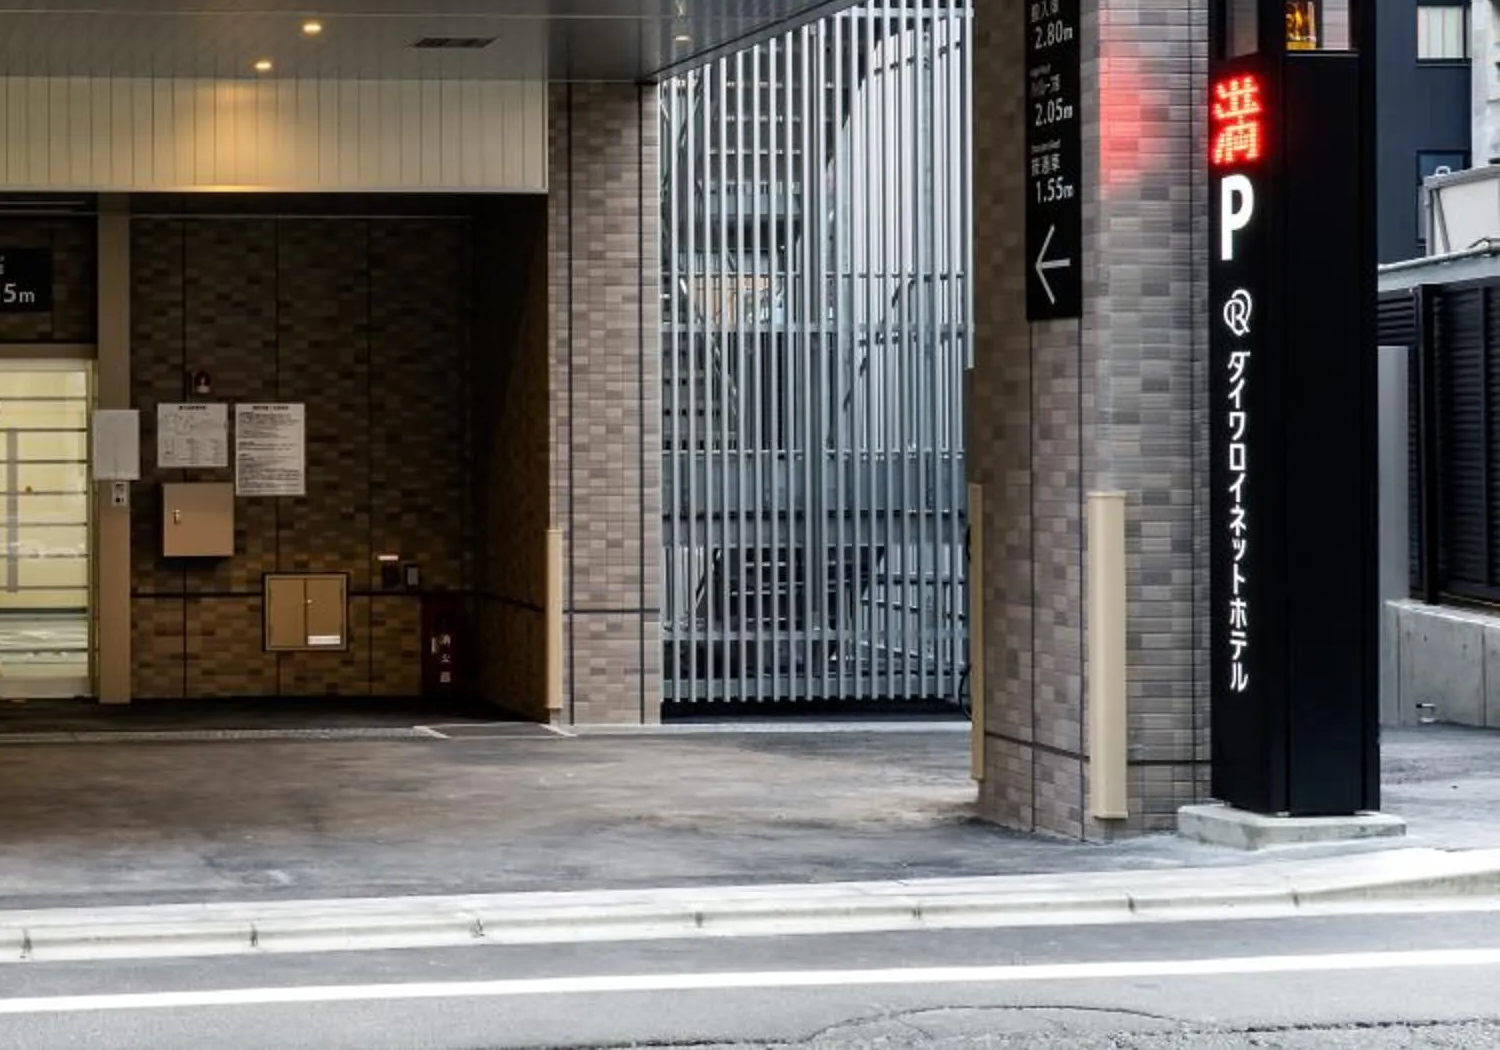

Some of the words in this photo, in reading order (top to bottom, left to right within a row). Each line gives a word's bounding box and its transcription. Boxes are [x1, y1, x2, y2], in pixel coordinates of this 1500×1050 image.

[1034, 20, 1073, 50] 2.80m
[1034, 97, 1073, 127] 2.05m
[1035, 176, 1074, 205] 1.55m
[1221, 174, 1254, 261] P
[1227, 351, 1251, 692] ダイワロイネットホテル
